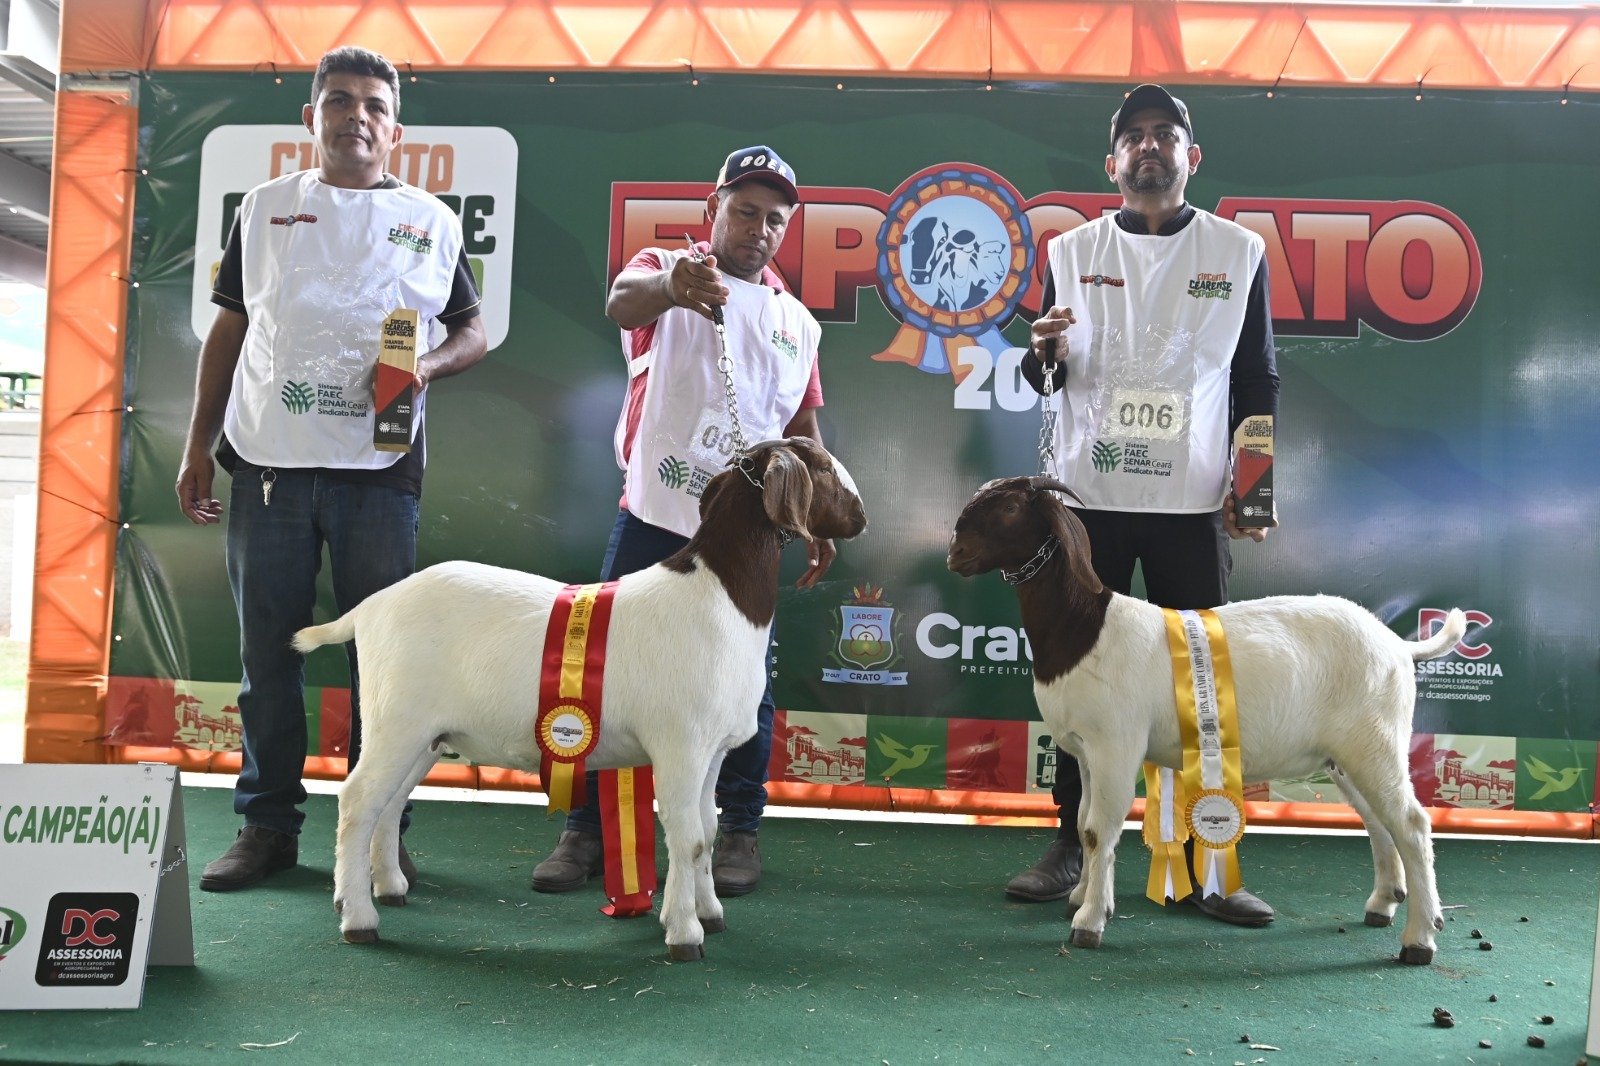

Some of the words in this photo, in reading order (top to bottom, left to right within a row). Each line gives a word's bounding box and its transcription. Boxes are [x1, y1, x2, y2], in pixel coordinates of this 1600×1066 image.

[270, 142, 454, 193] CIITO
[740, 155, 787, 177] BOER
[389, 228, 433, 248] CEARENSE
[1189, 280, 1232, 292] CEARENSE
[954, 345, 1061, 412] 20
[318, 389, 343, 399] FAEC
[318, 399, 346, 408] SENAR
[318, 408, 349, 416] Sindicato
[1120, 402, 1173, 429] 006
[702, 425, 736, 456] 00
[1124, 449, 1149, 458] FAEC
[1123, 458, 1151, 466] SENAR
[694, 465, 714, 477] Sistem
[1123, 467, 1153, 475] Sindicato
[689, 480, 705, 491] SEN
[685, 488, 702, 499] Sindi
[916, 612, 1034, 662] Cra
[961, 665, 1034, 676] PREFEITU
[1417, 661, 1503, 676] SSESSORIA
[849, 672, 881, 681] CRATO
[1456, 677, 1494, 685] EXPOSIÇÕES
[1426, 691, 1491, 701] dcassessoriaagro
[3, 795, 160, 854] CAMPEÃO(Ã)
[61, 908, 120, 946] DC
[47, 949, 123, 960] ASSESSORIA
